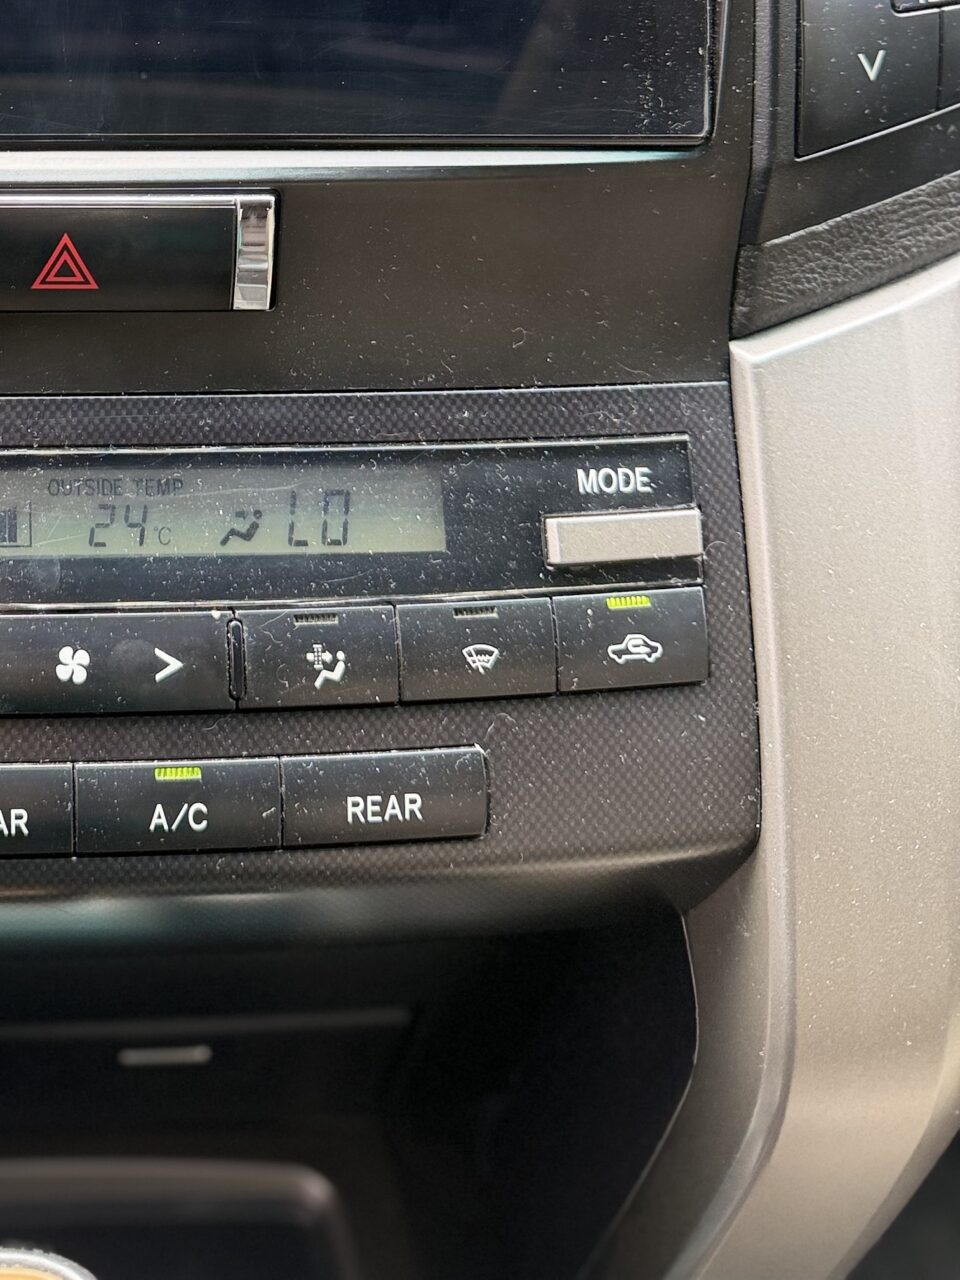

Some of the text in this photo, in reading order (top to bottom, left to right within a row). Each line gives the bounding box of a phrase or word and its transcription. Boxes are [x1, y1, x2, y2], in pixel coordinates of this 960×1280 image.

[47, 478, 184, 496] OUTSIDE TEMP
[577, 467, 653, 495] MODE
[149, 803, 208, 832] A/C
[346, 793, 423, 824] REAR
